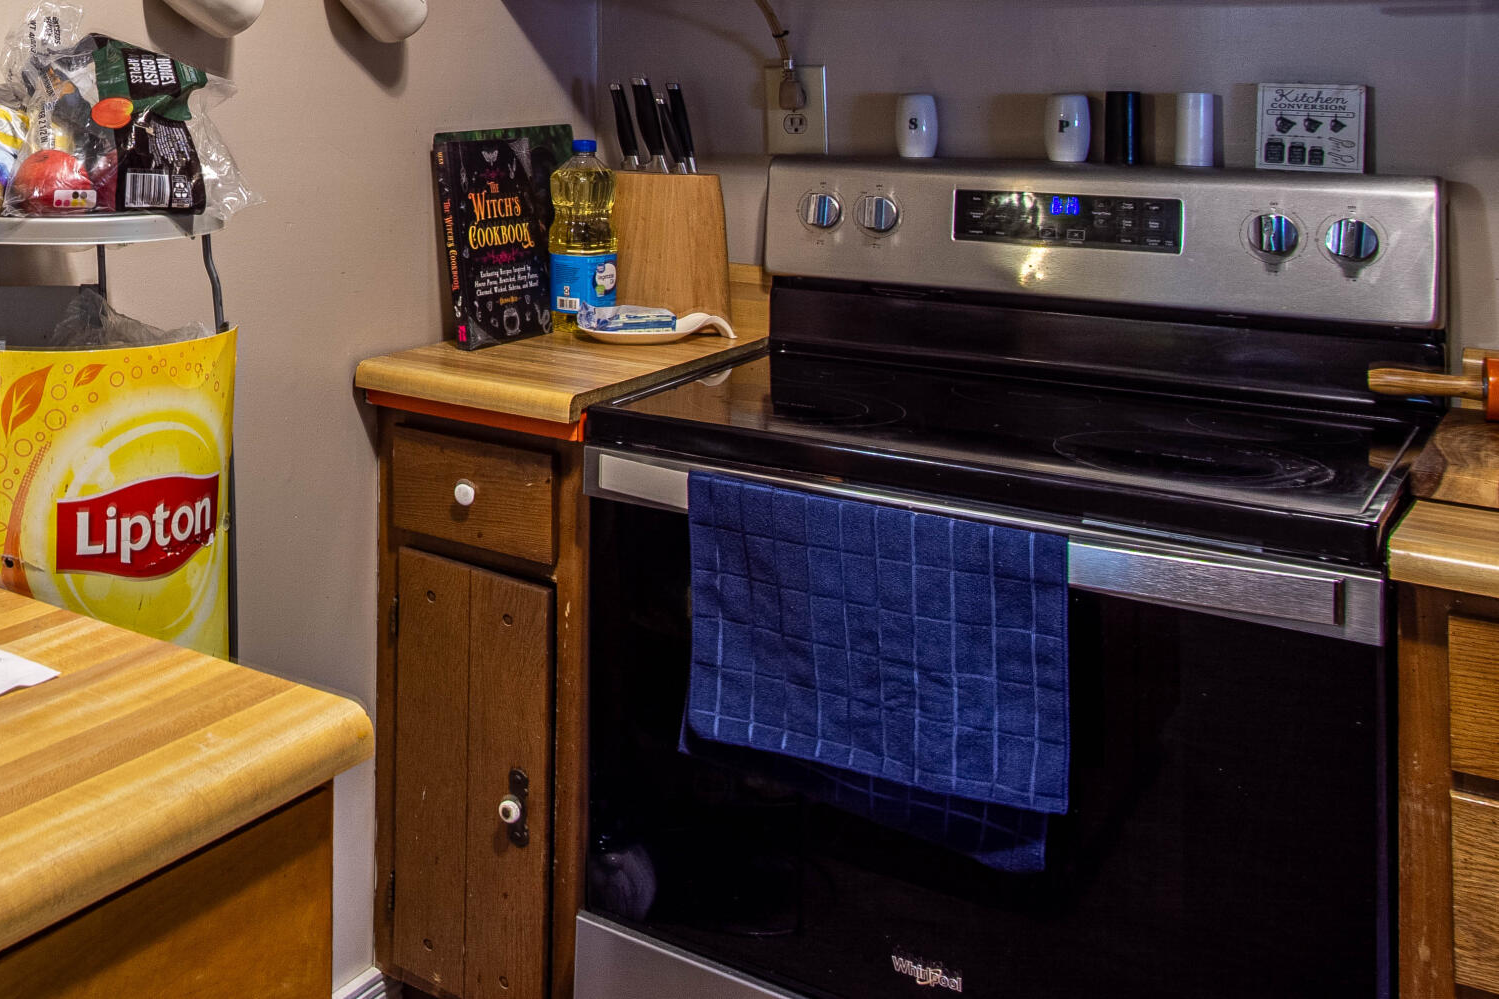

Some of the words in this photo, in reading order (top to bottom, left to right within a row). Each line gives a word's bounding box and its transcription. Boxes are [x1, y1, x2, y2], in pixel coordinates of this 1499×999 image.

[128, 57, 143, 84] APPLES
[142, 57, 160, 85] CRISP
[158, 56, 176, 85] HONEY
[1270, 102, 1348, 112] CONVERSION
[1274, 88, 1349, 106] Kitchen
[908, 117, 919, 131] S
[1058, 119, 1070, 133] P
[75, 496, 212, 564] Lipton
[891, 955, 963, 993] Whirlpool
